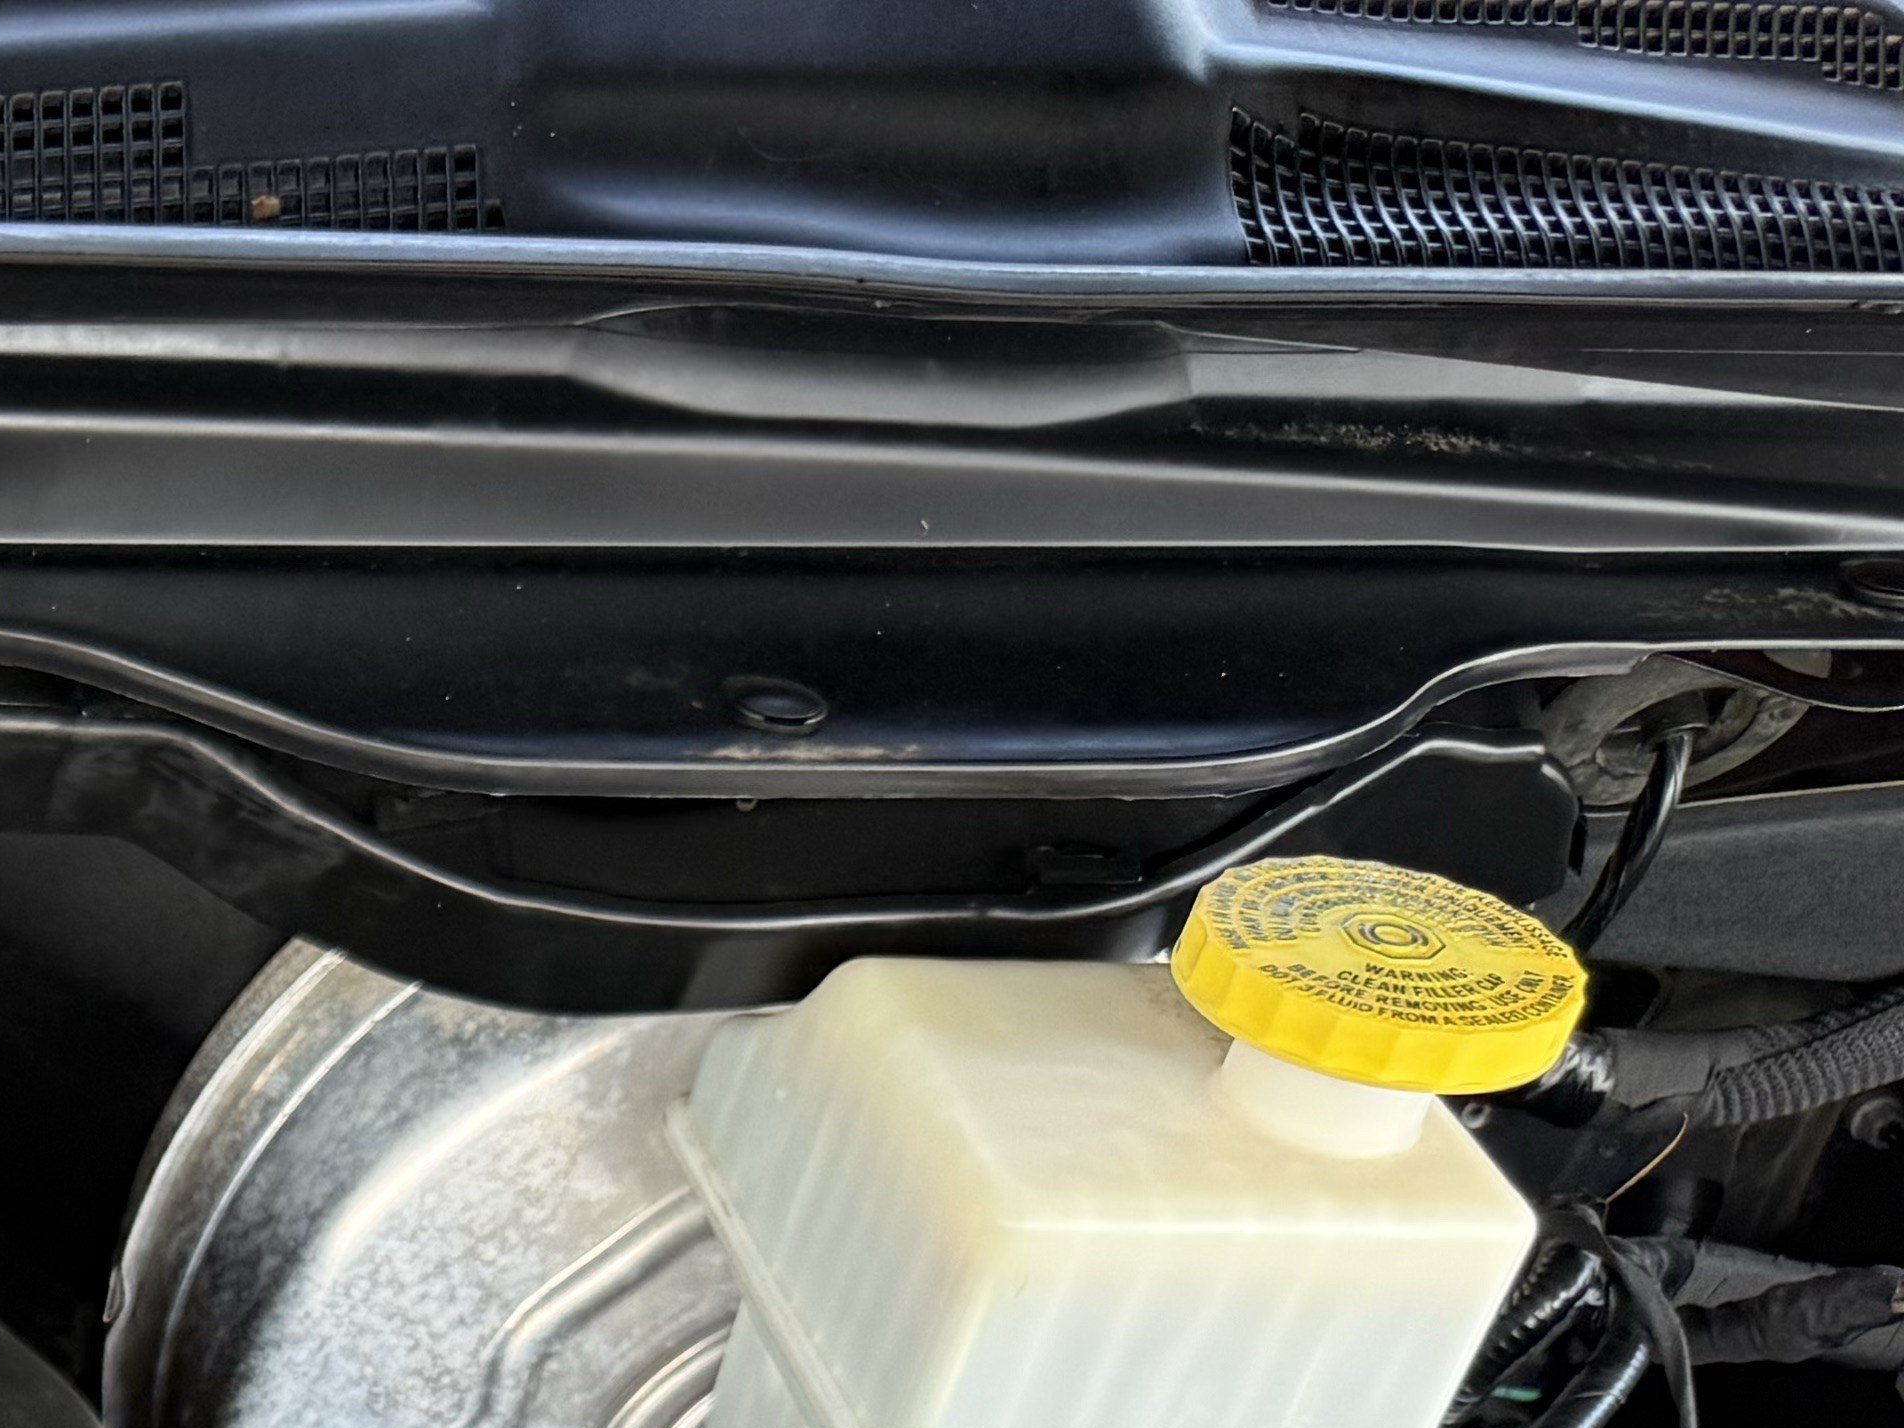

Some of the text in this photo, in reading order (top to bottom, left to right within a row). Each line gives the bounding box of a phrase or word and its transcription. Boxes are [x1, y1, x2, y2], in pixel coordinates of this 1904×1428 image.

[1286, 963, 1366, 998] BEFORE
[1489, 990, 1527, 1007] USE
[1337, 970, 1505, 998] CLEAN FILLER CAP
[1364, 962, 1473, 983] WARNING:
[1258, 964, 1301, 985] DOT
[1300, 983, 1314, 993] 3
[1313, 988, 1373, 1013] FLUID
[1378, 1007, 1440, 1025] FROM
[1441, 1015, 1458, 1026] A
[1459, 1009, 1528, 1027] SEALED
